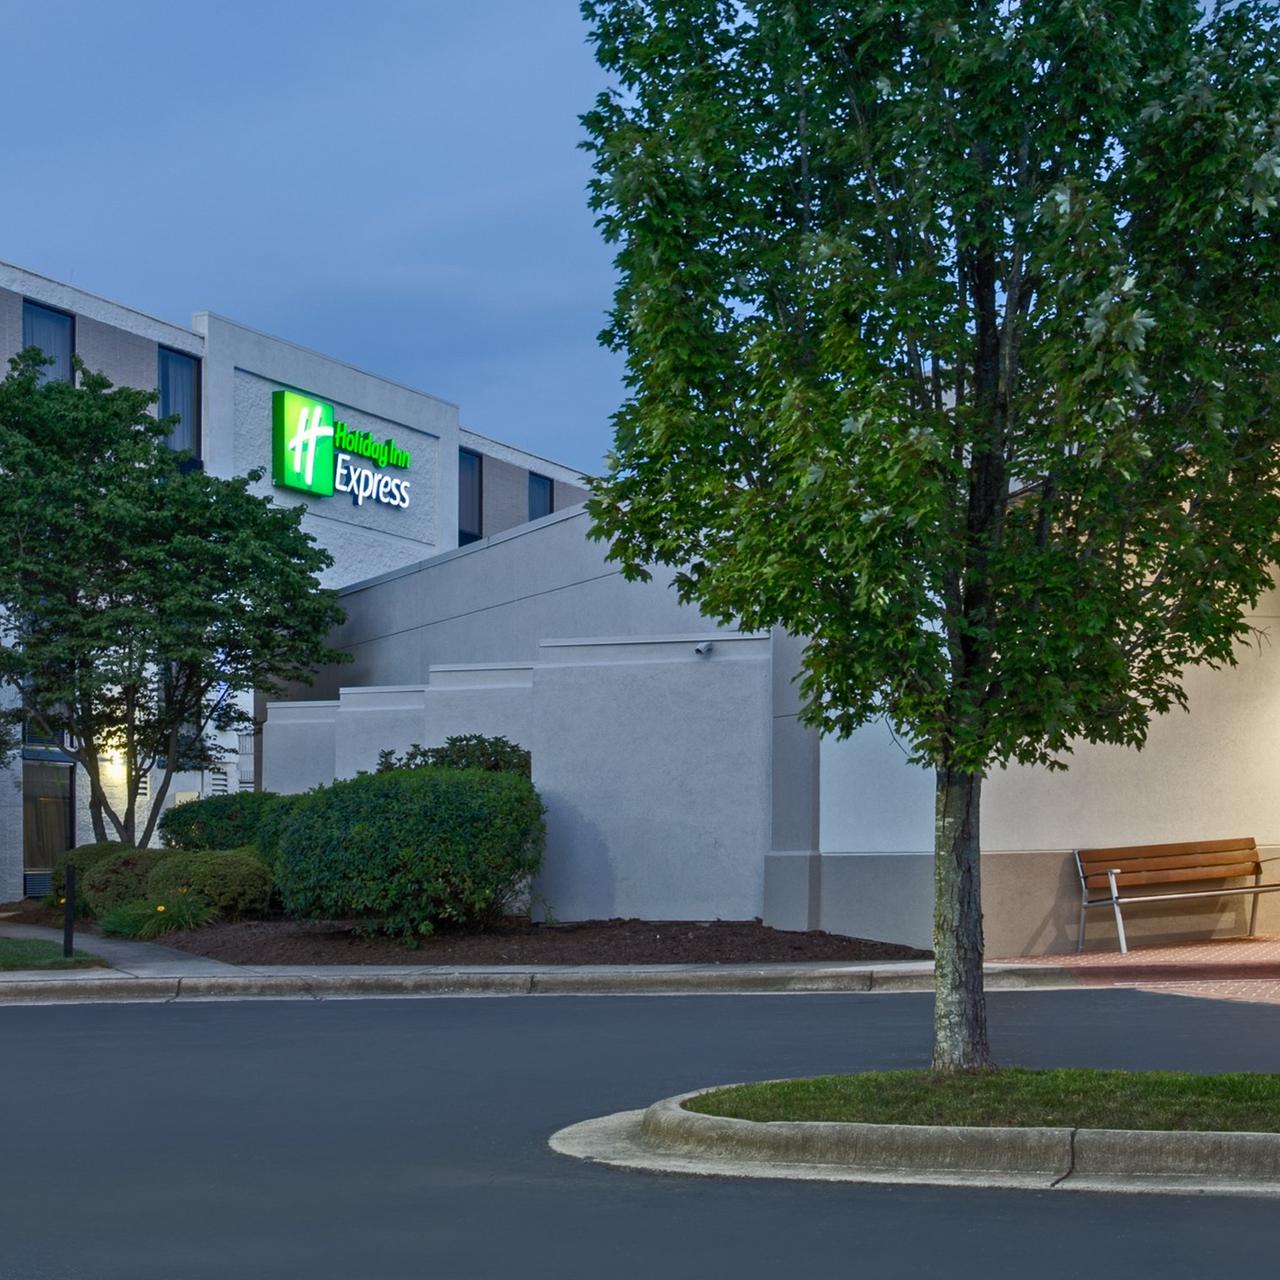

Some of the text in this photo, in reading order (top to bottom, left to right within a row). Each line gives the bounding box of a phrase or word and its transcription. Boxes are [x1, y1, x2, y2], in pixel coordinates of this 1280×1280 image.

[335, 421, 411, 467] Holiday Inn
[335, 453, 410, 508] Express
